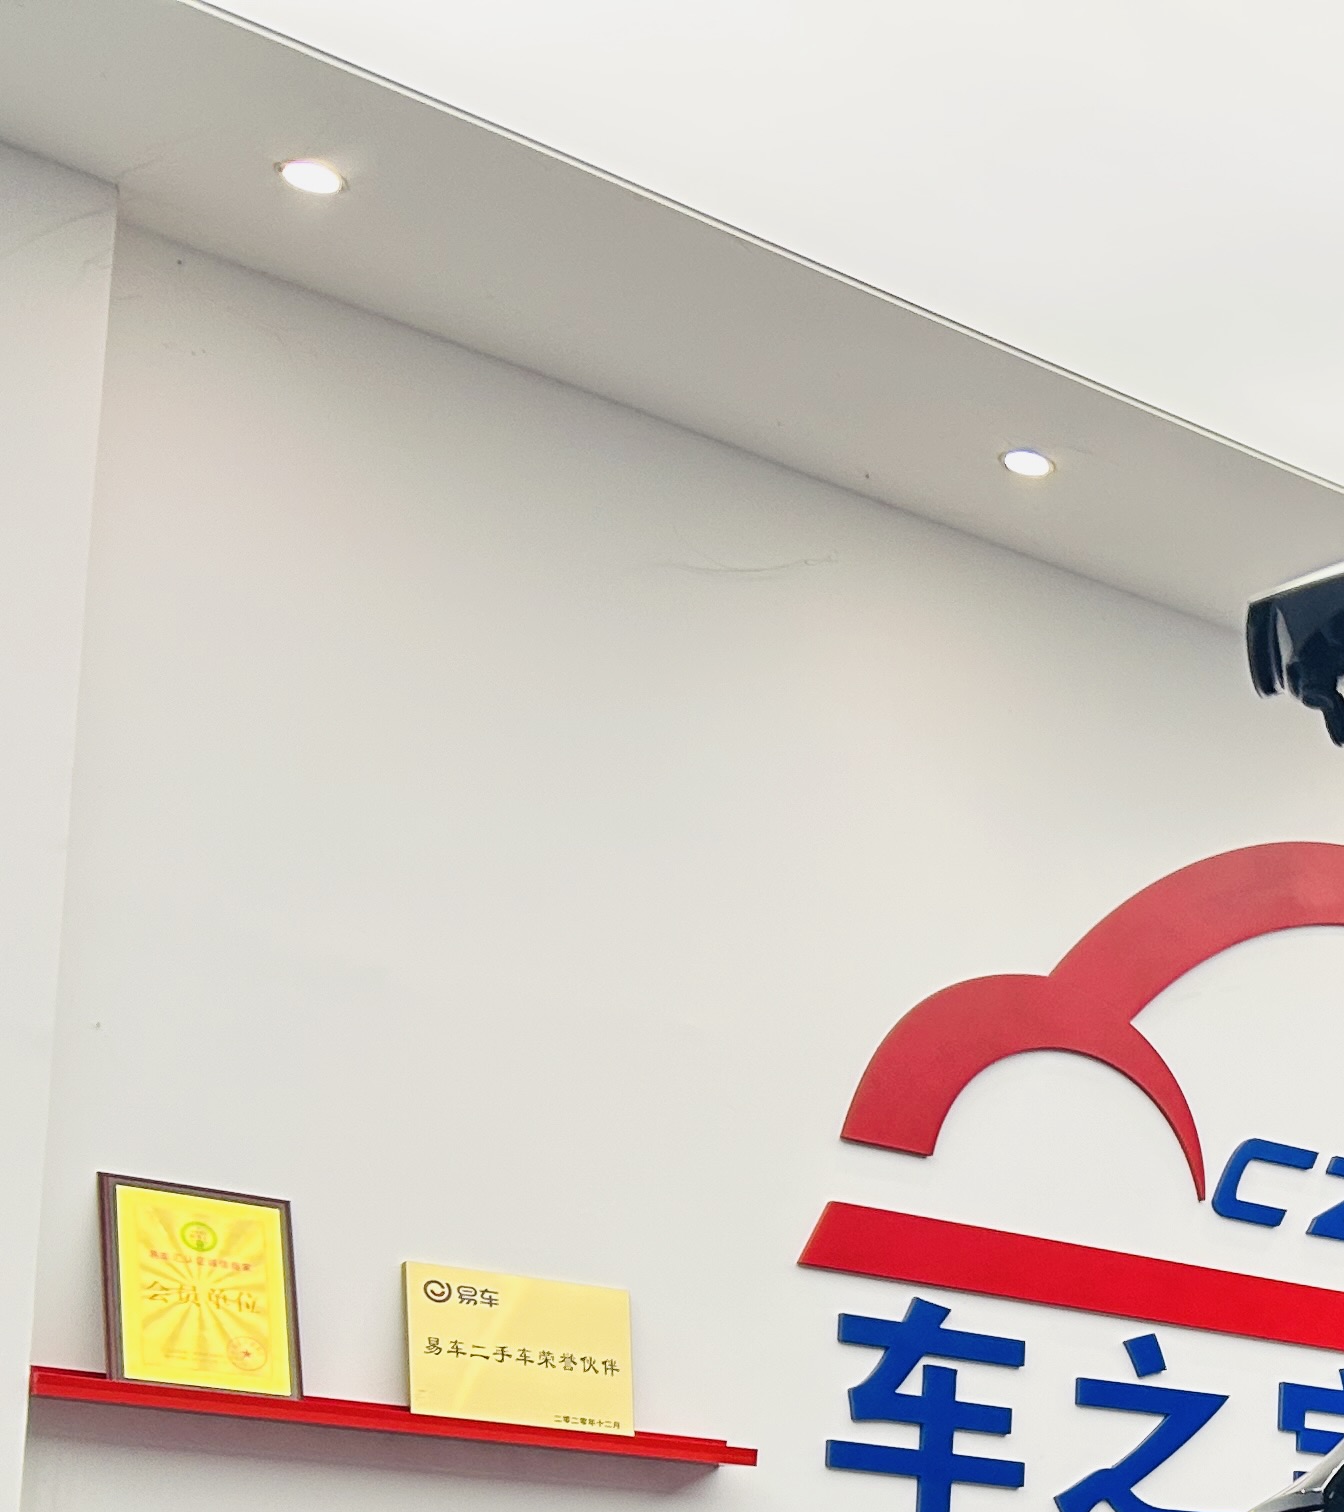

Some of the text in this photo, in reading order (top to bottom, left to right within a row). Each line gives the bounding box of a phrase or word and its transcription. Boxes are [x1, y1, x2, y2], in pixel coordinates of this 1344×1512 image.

[456, 1285, 500, 1308] 易车
[423, 1336, 621, 1377] 易车二手车荣誉伙伴
